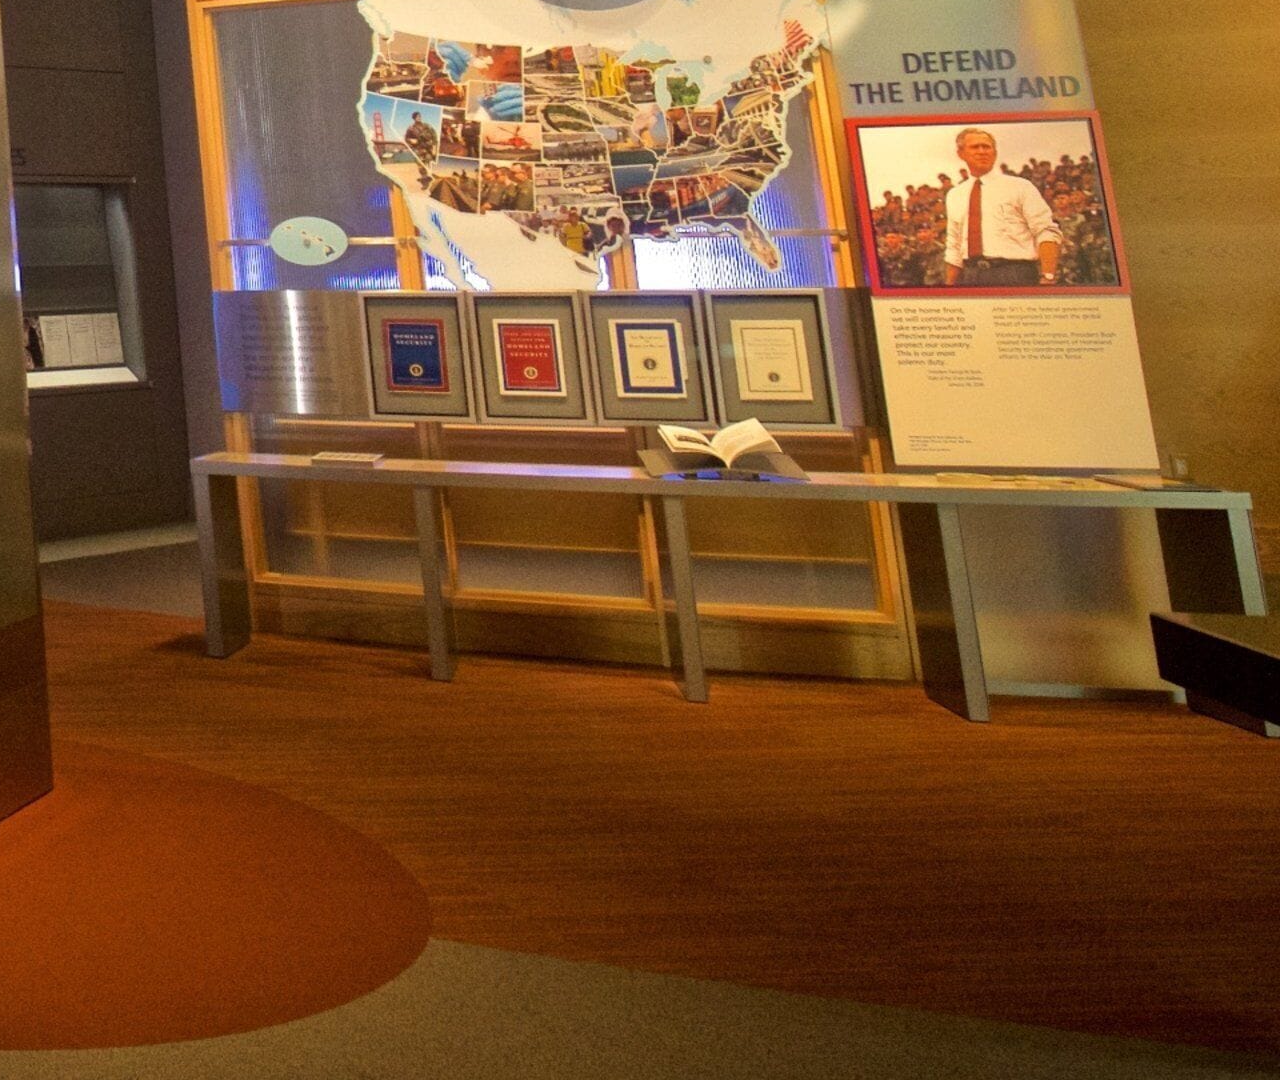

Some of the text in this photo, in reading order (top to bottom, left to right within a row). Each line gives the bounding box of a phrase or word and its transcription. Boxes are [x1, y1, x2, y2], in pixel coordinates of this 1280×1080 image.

[901, 47, 1016, 75] DEFEND
[849, 75, 1081, 106] THE HOMELAND
